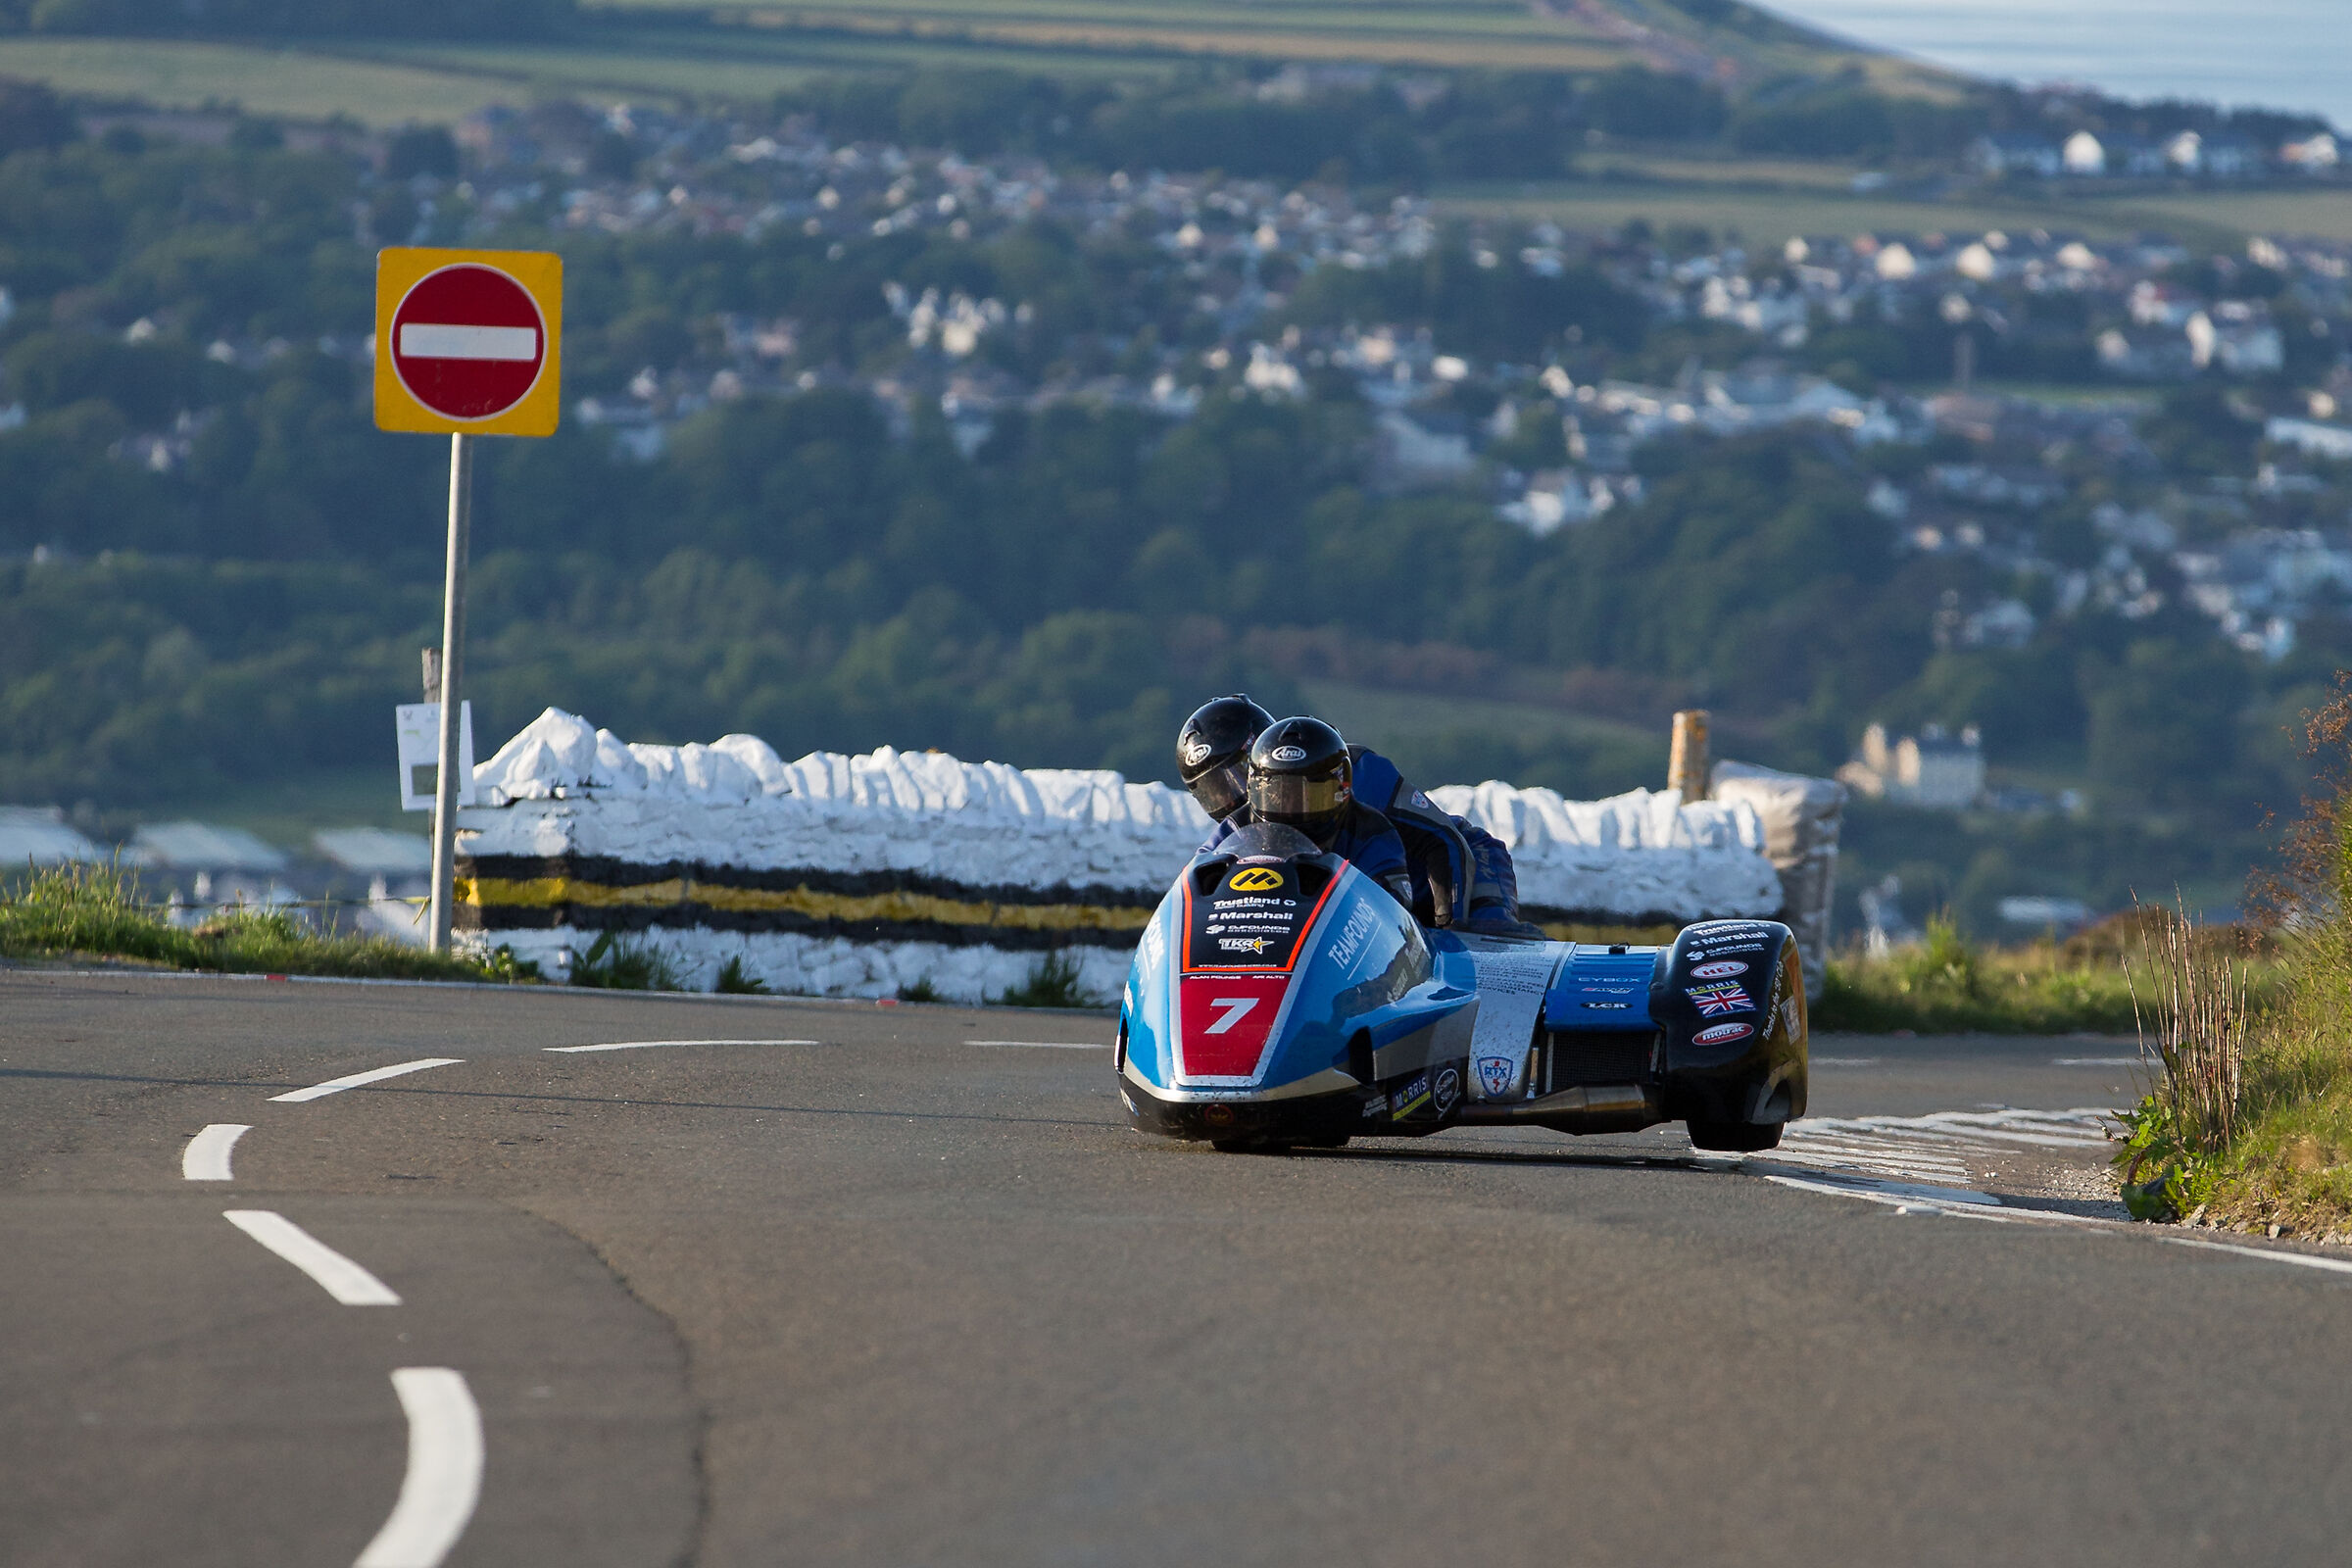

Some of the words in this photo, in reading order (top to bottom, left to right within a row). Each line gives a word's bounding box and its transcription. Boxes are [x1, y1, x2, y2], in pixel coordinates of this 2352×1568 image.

[1274, 747, 1301, 759] Arai
[1213, 897, 1281, 909] Trustland
[1220, 911, 1293, 920] Marshall
[1328, 897, 1376, 970] TEAMFOUNDS
[1701, 931, 1770, 945] Marshall
[1703, 964, 1740, 976] HEL
[1686, 980, 1739, 994] MORRIS
[1203, 998, 1260, 1034] 7
[1702, 1025, 1745, 1041] motrac
[1484, 1066, 1507, 1077] RTX
[1395, 1077, 1428, 1107] MORRIS
